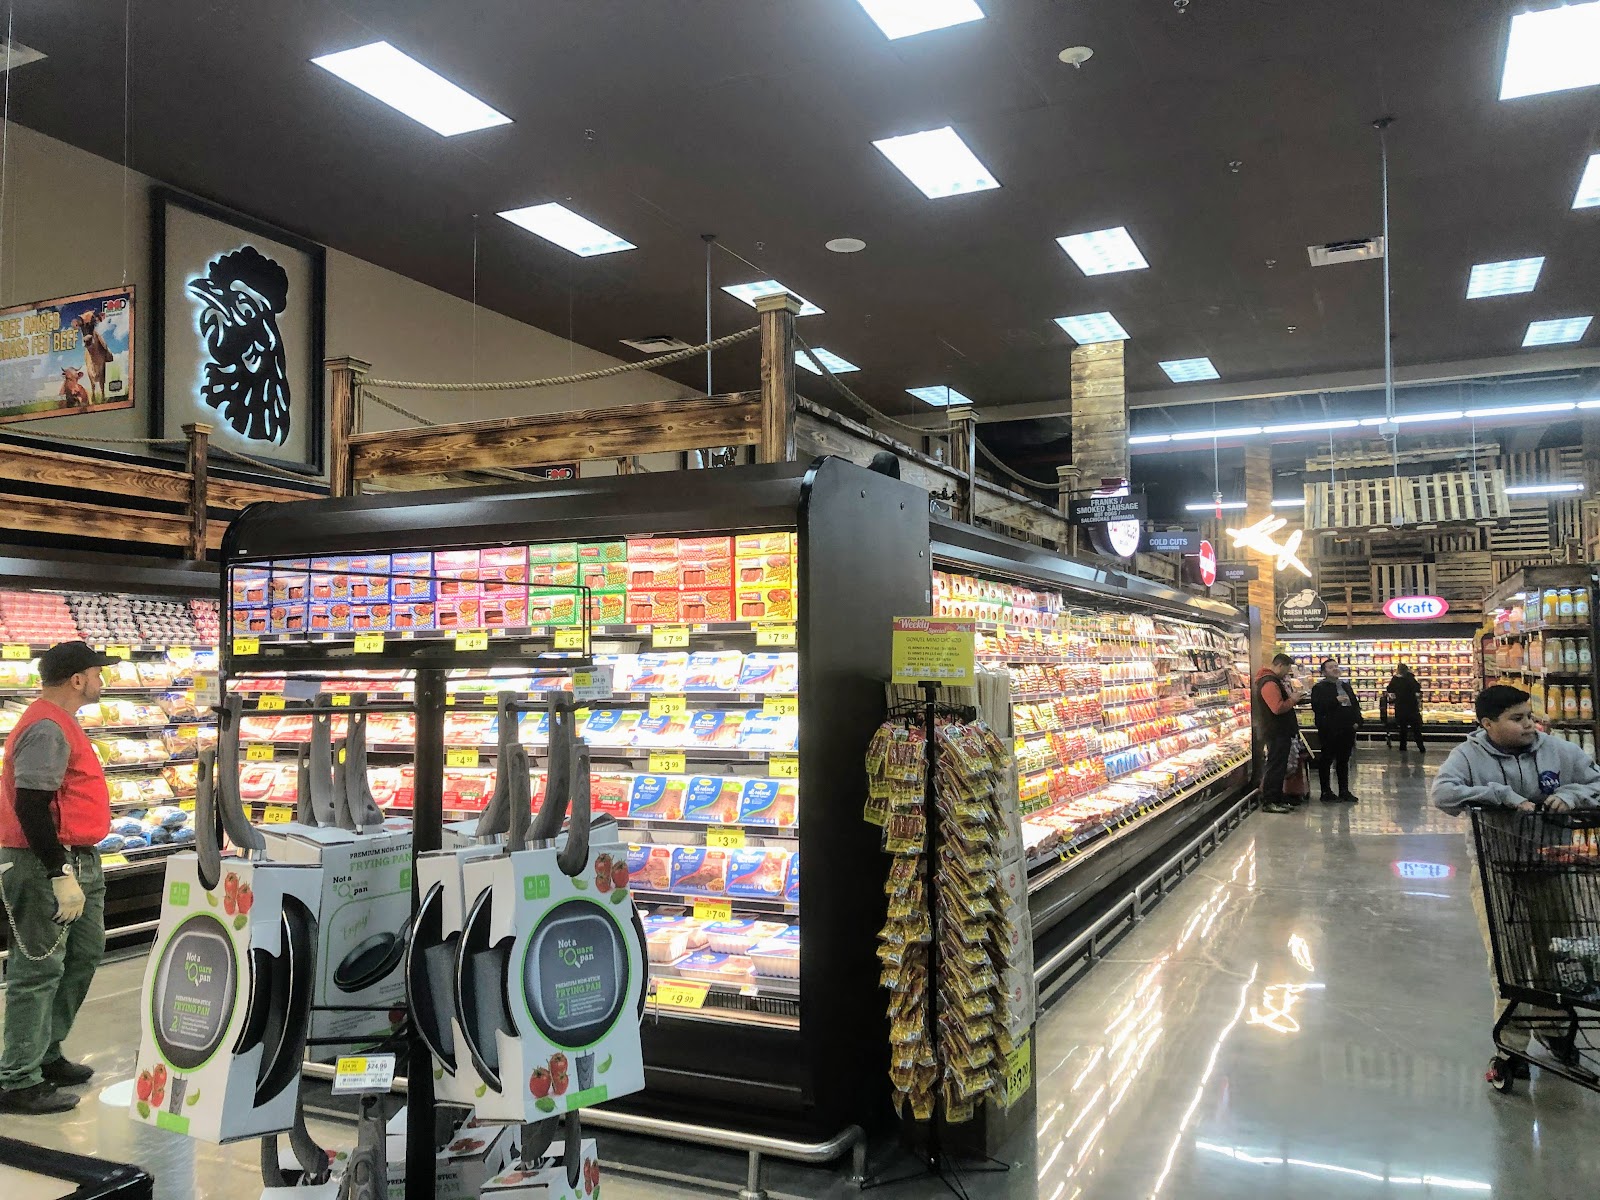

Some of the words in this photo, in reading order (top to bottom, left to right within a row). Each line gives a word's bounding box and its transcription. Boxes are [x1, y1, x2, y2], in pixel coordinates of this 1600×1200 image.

[53, 330, 78, 352] BEEF
[1076, 506, 1106, 514] SMOKED
[1107, 502, 1138, 512] SAUSAGE
[1091, 498, 1118, 506] FRANKS
[1397, 601, 1433, 614] Kraft
[899, 618, 930, 631] Weekly
[350, 848, 380, 859] PREMIUM
[350, 857, 389, 872] FRYING
[392, 852, 411, 864] PAN
[354, 887, 368, 895] pan
[558, 939, 571, 948] Not
[186, 952, 197, 961] Not
[580, 954, 594, 964] pan
[556, 985, 585, 998] FRYING
[586, 981, 601, 992] PAN
[197, 1005, 210, 1016] PAN
[559, 1003, 566, 1016] 2
[172, 1016, 178, 1029] 2
